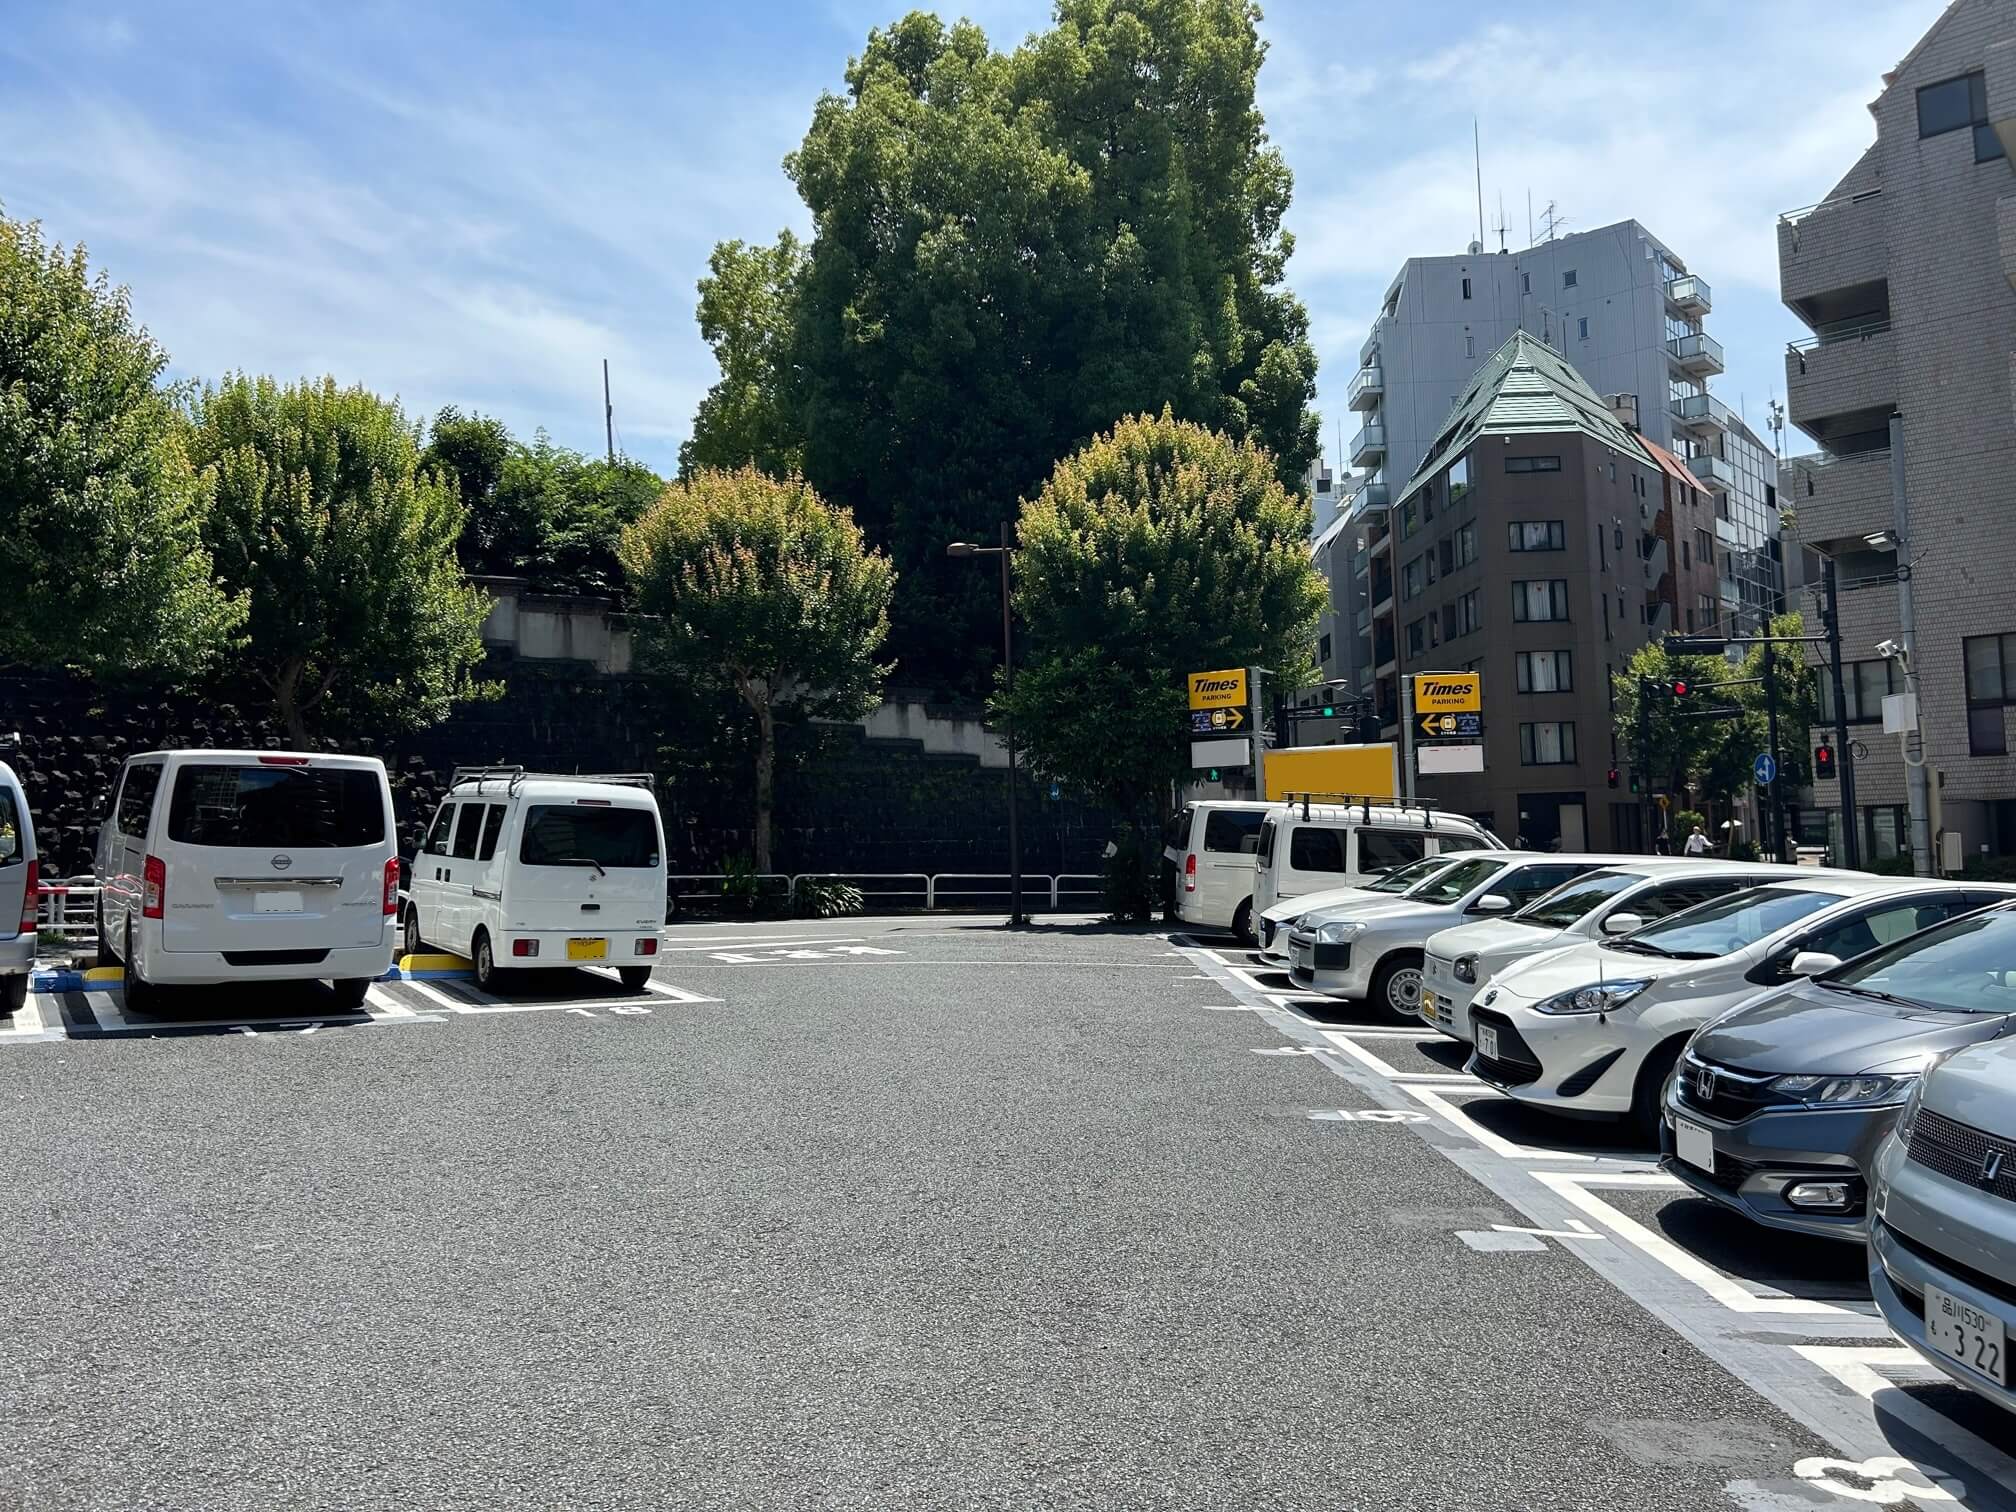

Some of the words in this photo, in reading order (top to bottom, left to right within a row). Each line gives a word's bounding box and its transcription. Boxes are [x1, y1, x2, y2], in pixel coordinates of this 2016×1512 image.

[1194, 679, 1239, 693] Times
[1423, 682, 1473, 696] Times
[1202, 693, 1232, 701] PARKING
[705, 946, 908, 964] 止まれ
[565, 1006, 653, 1017] 18
[228, 1022, 324, 1037] 17
